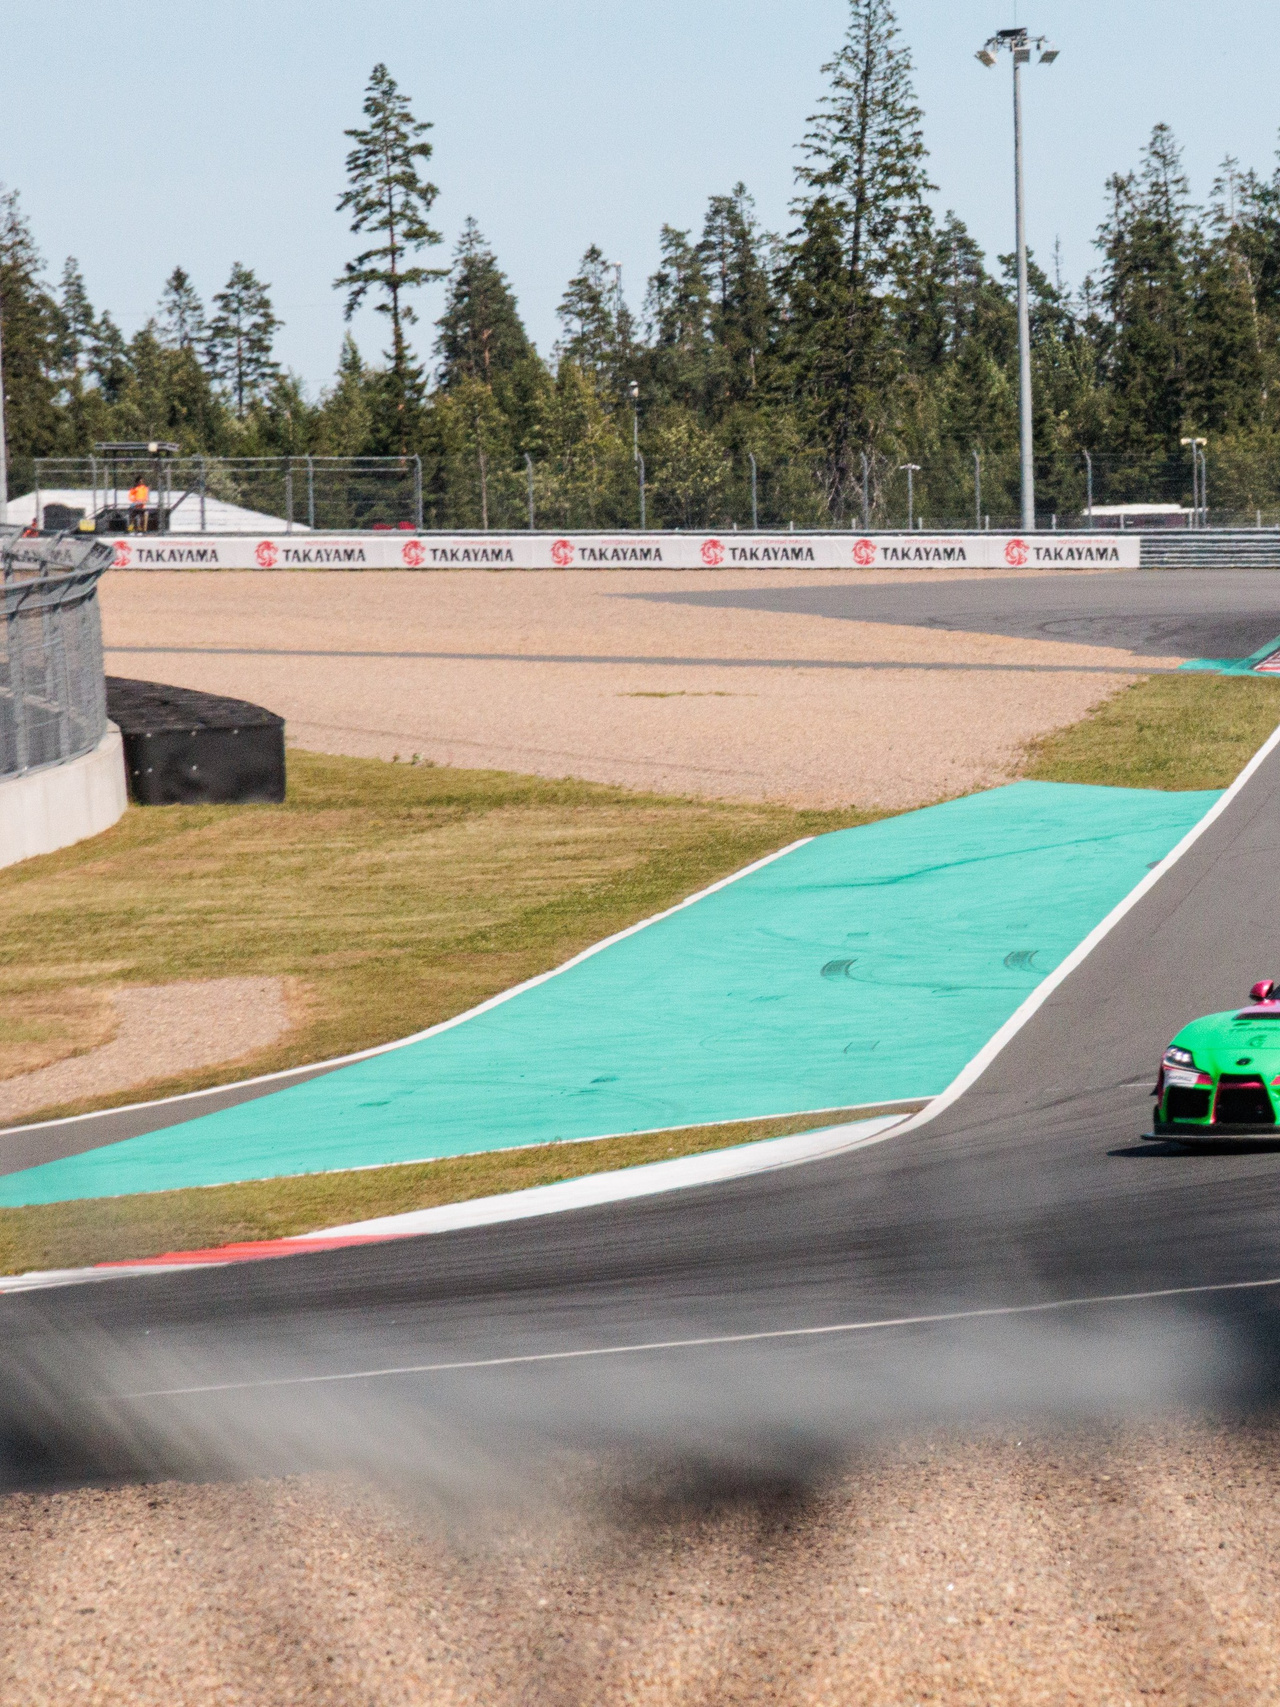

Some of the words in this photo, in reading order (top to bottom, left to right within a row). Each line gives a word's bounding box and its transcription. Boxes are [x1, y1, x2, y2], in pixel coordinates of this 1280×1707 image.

[136, 549, 219, 562] TAKAYAMA
[283, 549, 366, 562] TAKAYAMA
[430, 548, 514, 562] TAKAYAMA
[579, 548, 663, 561] TAKAYAMA
[729, 547, 815, 561] TAKAYAMA
[881, 547, 967, 561] TAKAYAMA
[1033, 547, 1119, 561] TAKAYAMA
